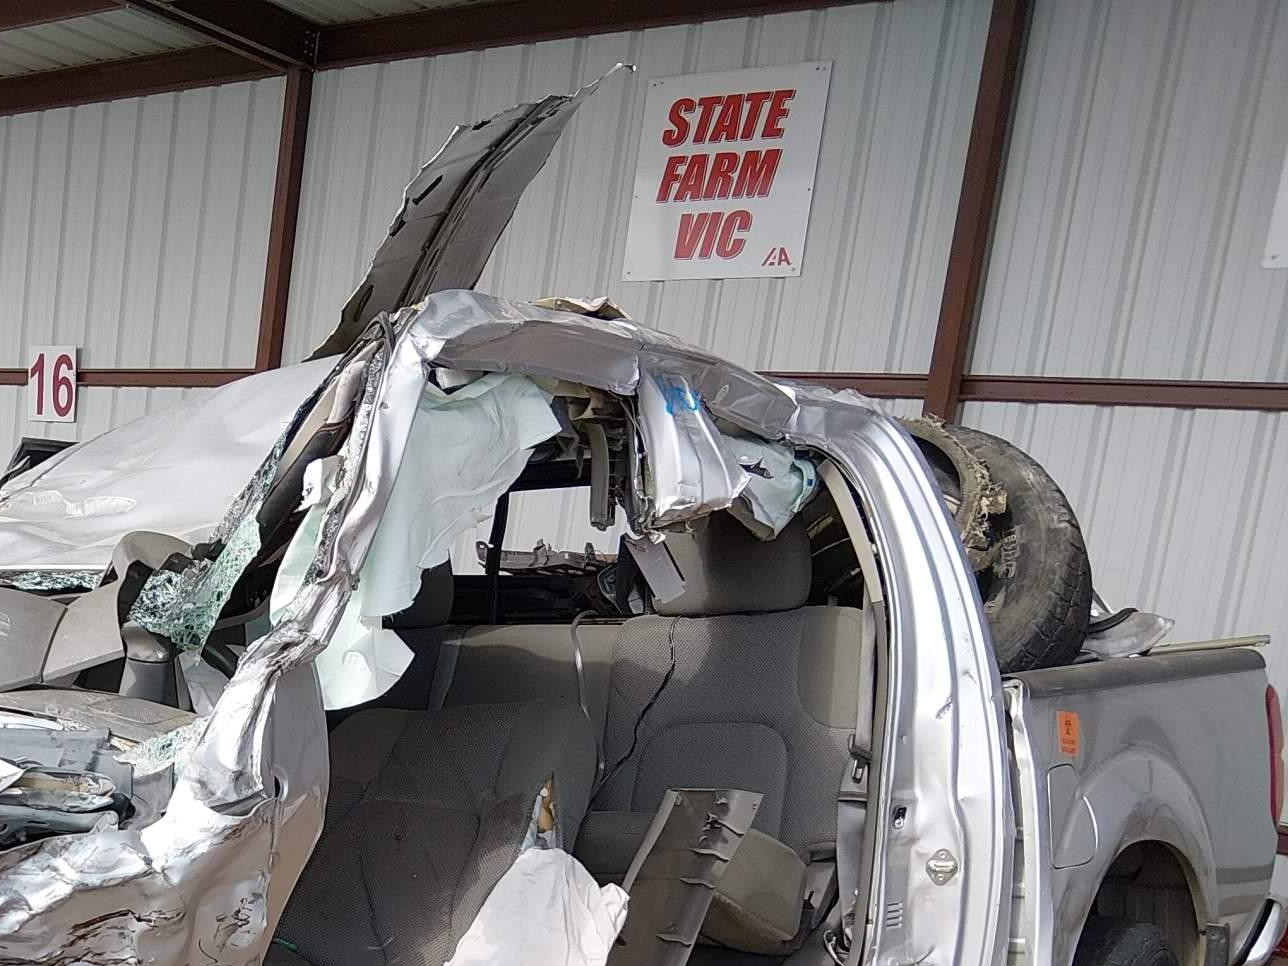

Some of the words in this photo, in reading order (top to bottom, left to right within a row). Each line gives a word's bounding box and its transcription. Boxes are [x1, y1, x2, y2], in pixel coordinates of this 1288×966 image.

[662, 89, 797, 148] STATE
[656, 149, 783, 203] FARM
[674, 210, 753, 260] VIC
[31, 353, 73, 417] 16
